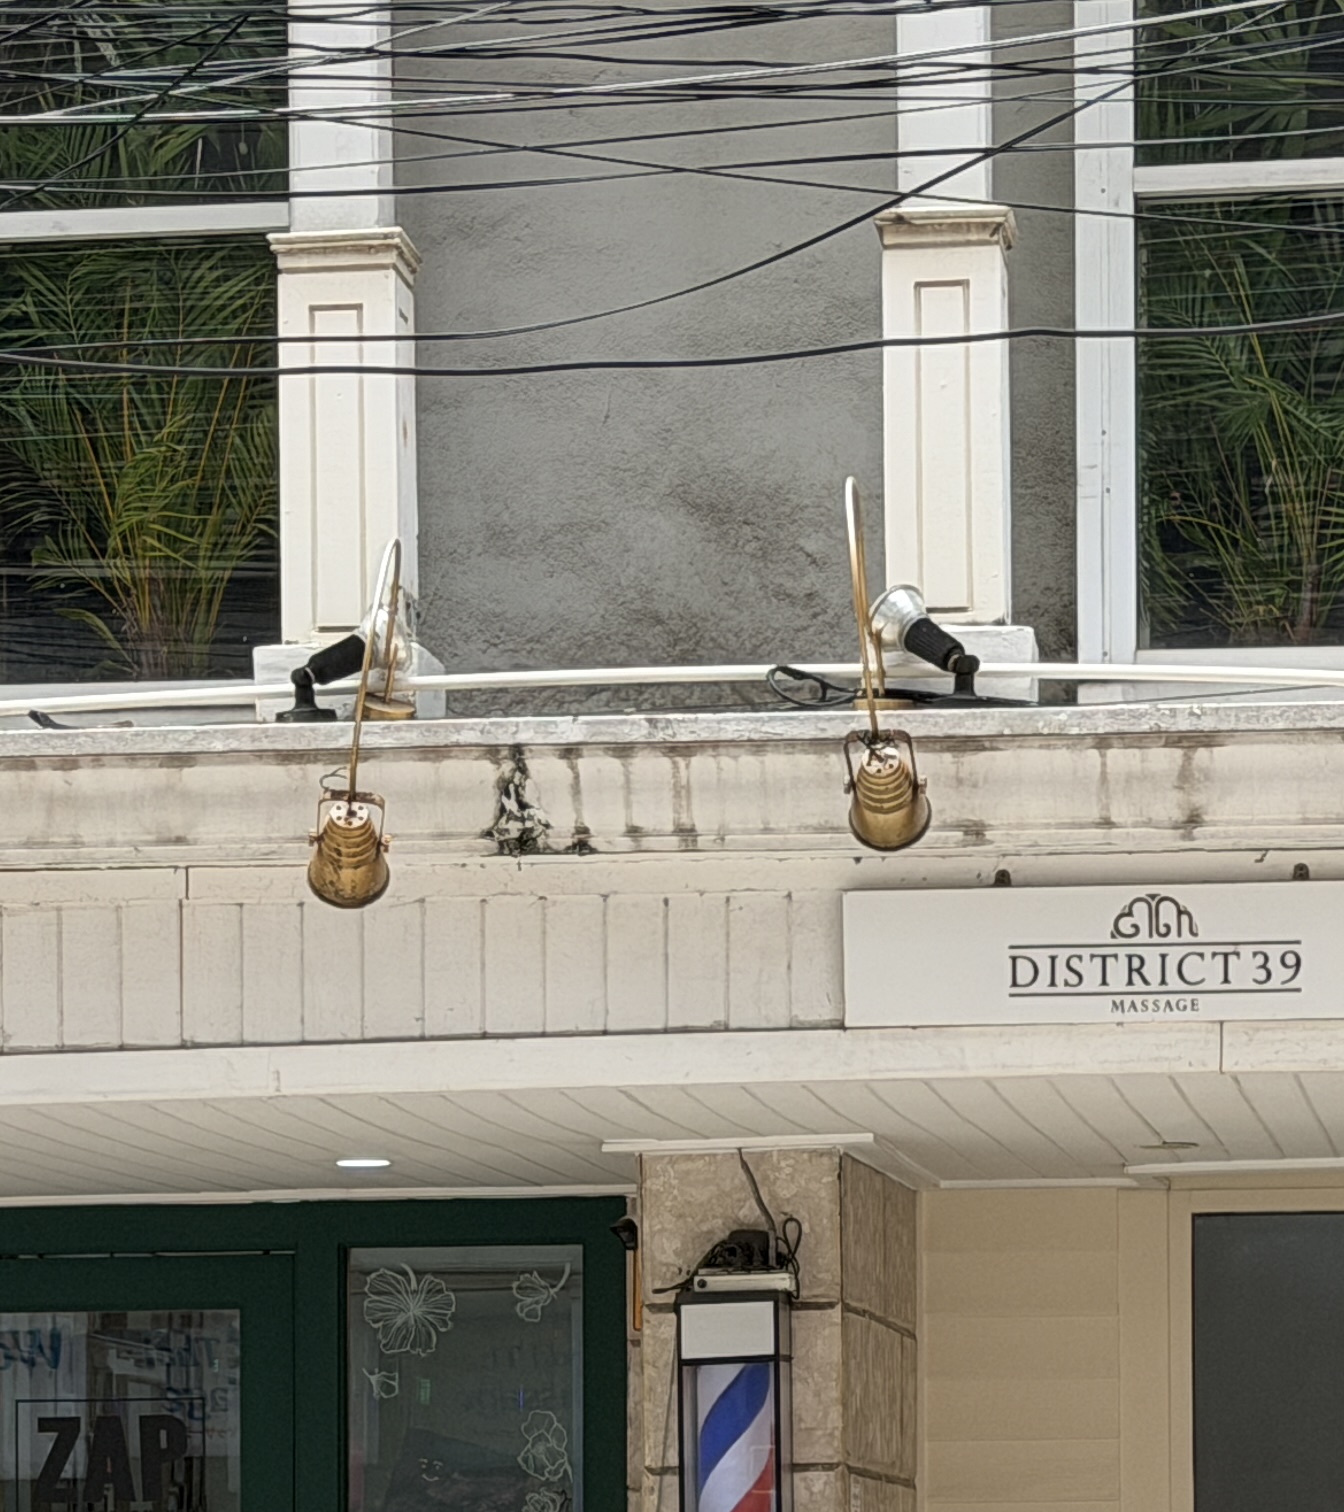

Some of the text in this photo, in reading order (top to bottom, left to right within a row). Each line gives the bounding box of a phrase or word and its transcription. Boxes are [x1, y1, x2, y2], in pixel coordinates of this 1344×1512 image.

[1009, 951, 1242, 989] DISTRICT
[1110, 997, 1201, 1014] MASSAGE
[32, 1414, 188, 1502] ZAP
